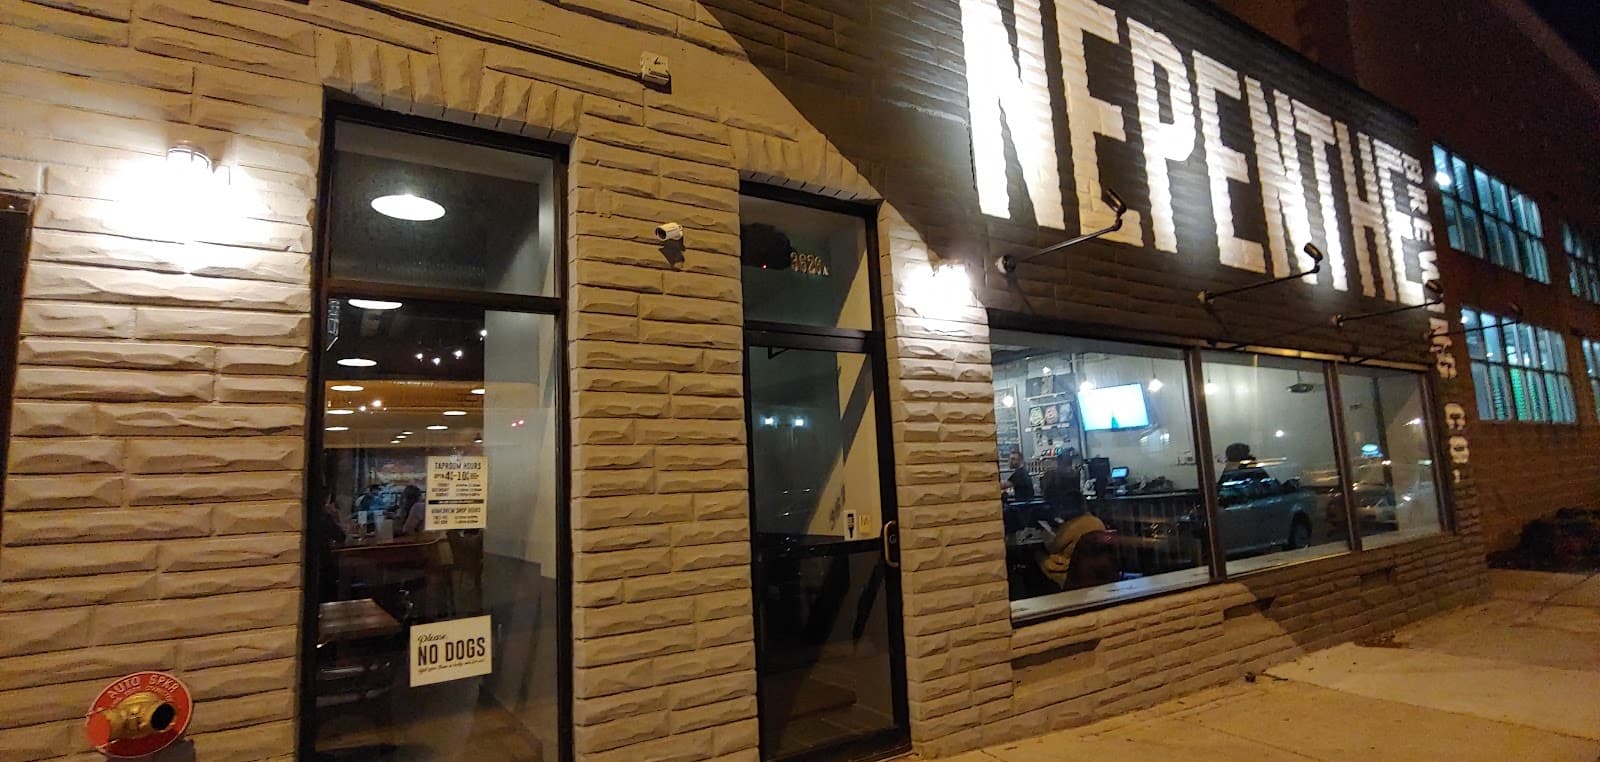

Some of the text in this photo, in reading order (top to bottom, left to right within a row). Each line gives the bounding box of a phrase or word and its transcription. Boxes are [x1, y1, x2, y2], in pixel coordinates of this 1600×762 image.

[960, 0, 1426, 307] NEPENTHE
[1401, 152, 1457, 380] BREWING
[107, 676, 141, 699] AUTO
[418, 644, 438, 666] NO
[445, 636, 486, 661] DOGS
